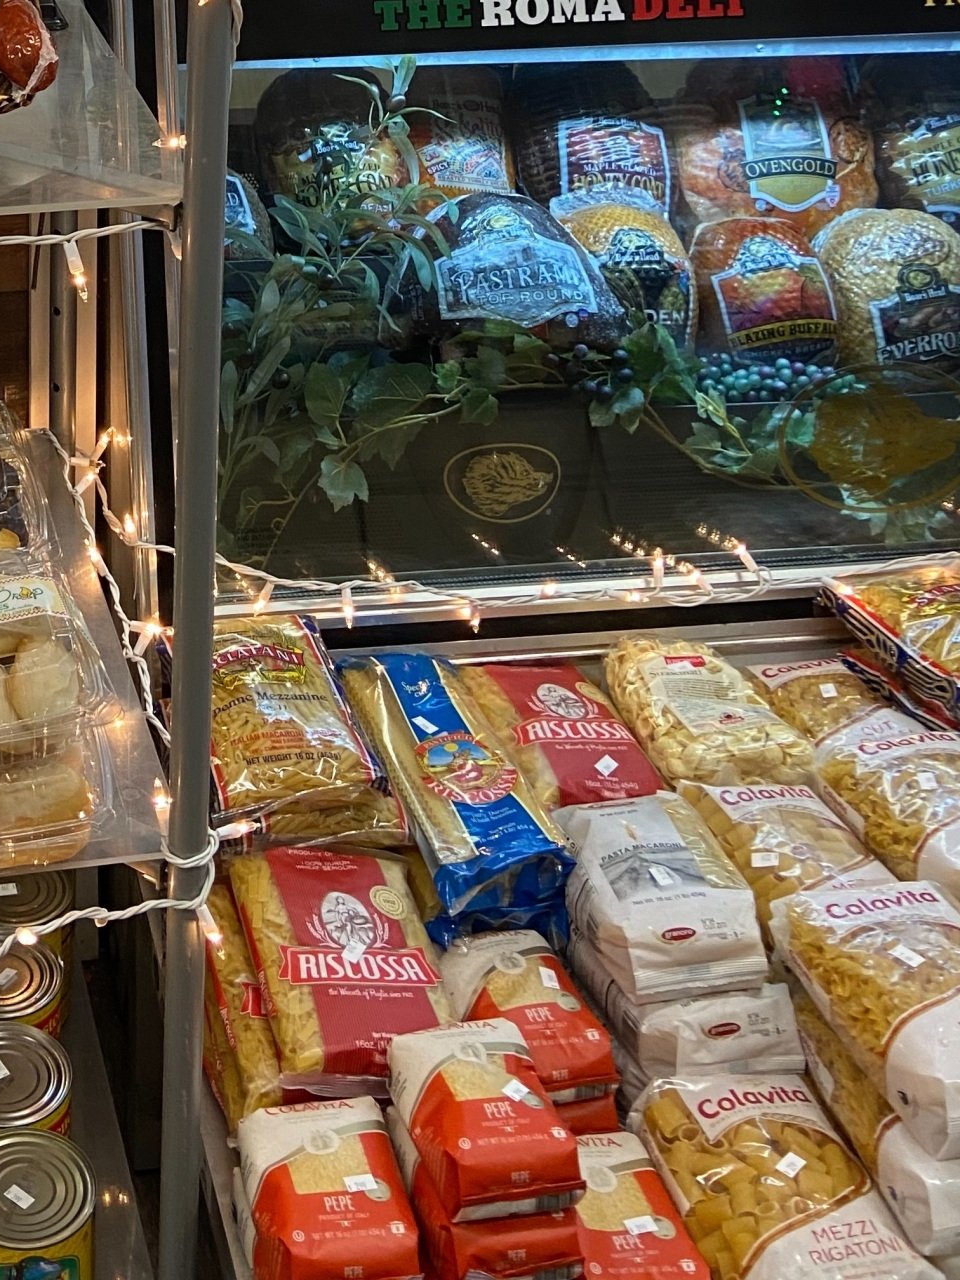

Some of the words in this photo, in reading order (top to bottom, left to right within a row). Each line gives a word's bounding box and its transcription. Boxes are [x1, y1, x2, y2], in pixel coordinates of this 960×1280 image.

[745, 157, 835, 178] OVENGOLD
[520, 291, 584, 302] ROUND
[526, 719, 633, 741] RISCOSSA
[857, 733, 956, 756] Colavita
[246, 757, 261, 765] NET
[264, 753, 293, 763] WEIGHT
[719, 786, 816, 806] Colavita
[601, 847, 630, 863] PASTA
[632, 842, 682, 850] MACARONI
[825, 890, 940, 919] Colavita
[298, 953, 428, 981] RISCOSSA
[524, 1007, 555, 1022] PEPE
[483, 1101, 513, 1118] PEPE
[697, 1086, 812, 1119] Colavita
[323, 1195, 355, 1212] PEPE
[811, 1220, 879, 1243] MEZZI
[808, 1237, 904, 1265] RIGATONI
